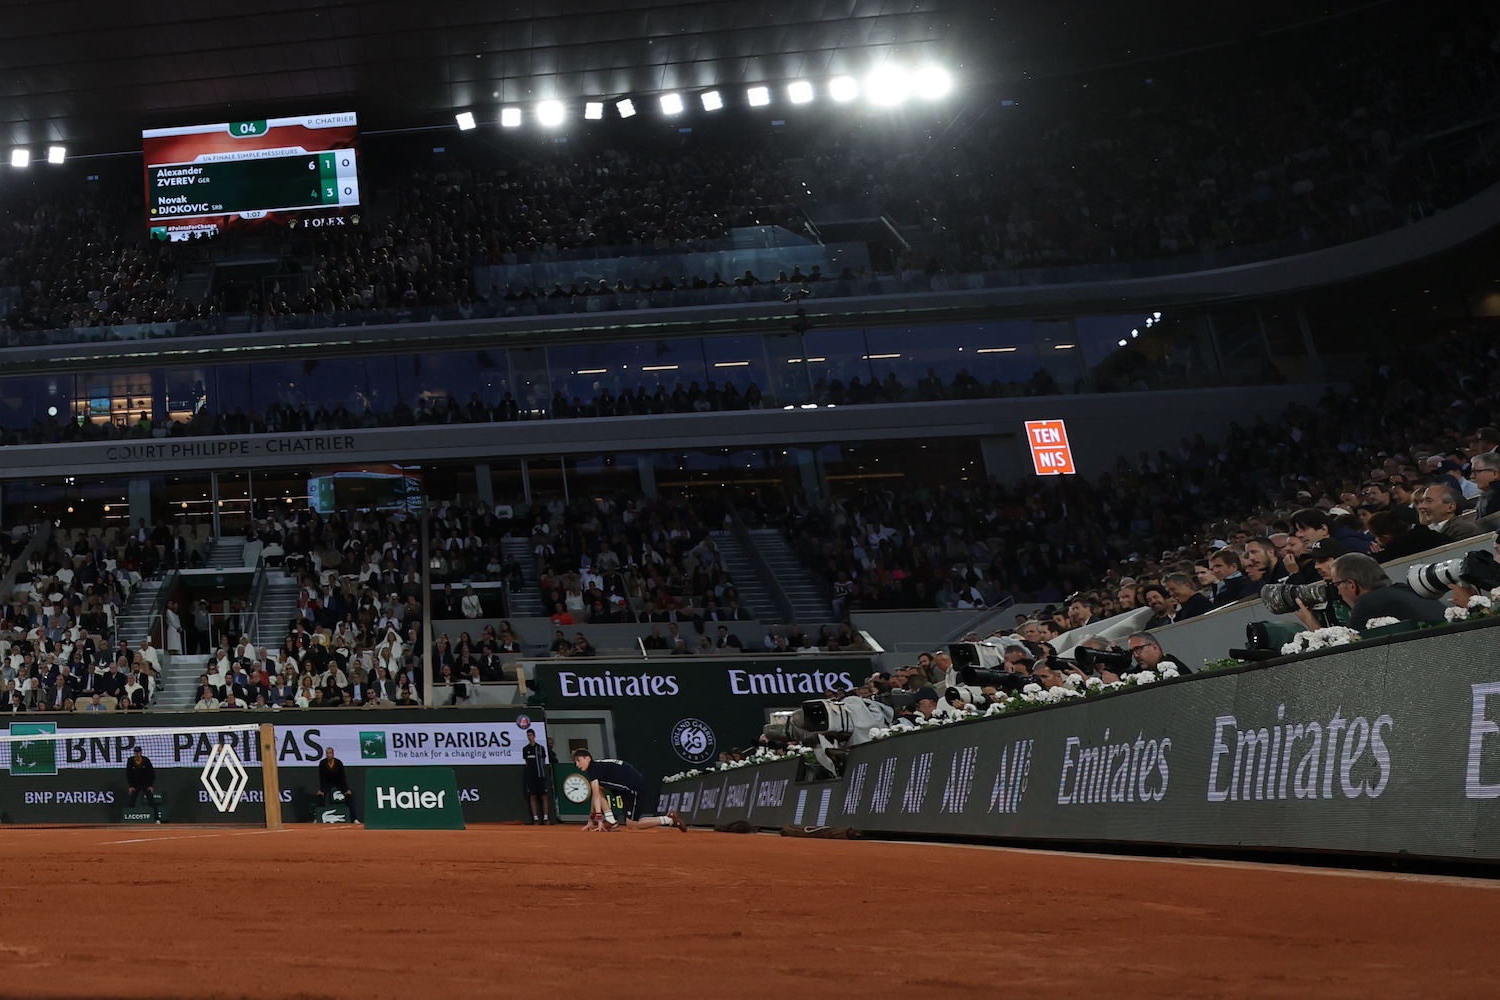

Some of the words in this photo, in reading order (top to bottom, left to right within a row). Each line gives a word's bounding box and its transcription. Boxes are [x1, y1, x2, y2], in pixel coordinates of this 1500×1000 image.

[315, 116, 354, 125] CHATRIER
[240, 123, 257, 134] 04
[237, 151, 259, 159] SIMPLE
[260, 149, 298, 158] MESSIEURS
[157, 166, 203, 178] Alexander
[308, 161, 316, 170] 6
[325, 160, 331, 169] 1
[157, 176, 195, 187] ZVEREV
[158, 195, 187, 205] Novak
[310, 189, 318, 198] 4
[326, 188, 334, 197] 3
[158, 203, 209, 214] DJOKOVIC
[1032, 428, 1061, 443] TEN
[106, 444, 166, 460] COURT
[171, 440, 249, 457] PHILIPPE
[266, 436, 355, 454] CHATRIER
[1039, 451, 1067, 467] NIS
[558, 670, 680, 697] Emirates
[728, 667, 854, 695] Emirates
[392, 732, 429, 749] BNP
[434, 731, 512, 748] PARIBAS
[674, 720, 691, 746] ROLAND
[692, 720, 713, 746] GARROS
[66, 735, 136, 763] BNP
[173, 729, 324, 763] PARIAS
[1207, 702, 1393, 802] Emirates
[394, 750, 408, 758] The
[410, 750, 429, 758] bank
[430, 750, 443, 760] for
[451, 750, 487, 759] changing
[1057, 727, 1172, 805] Emirates
[24, 791, 52, 804] BNP
[56, 790, 115, 804] PARIBAS
[376, 785, 446, 809] Haier
